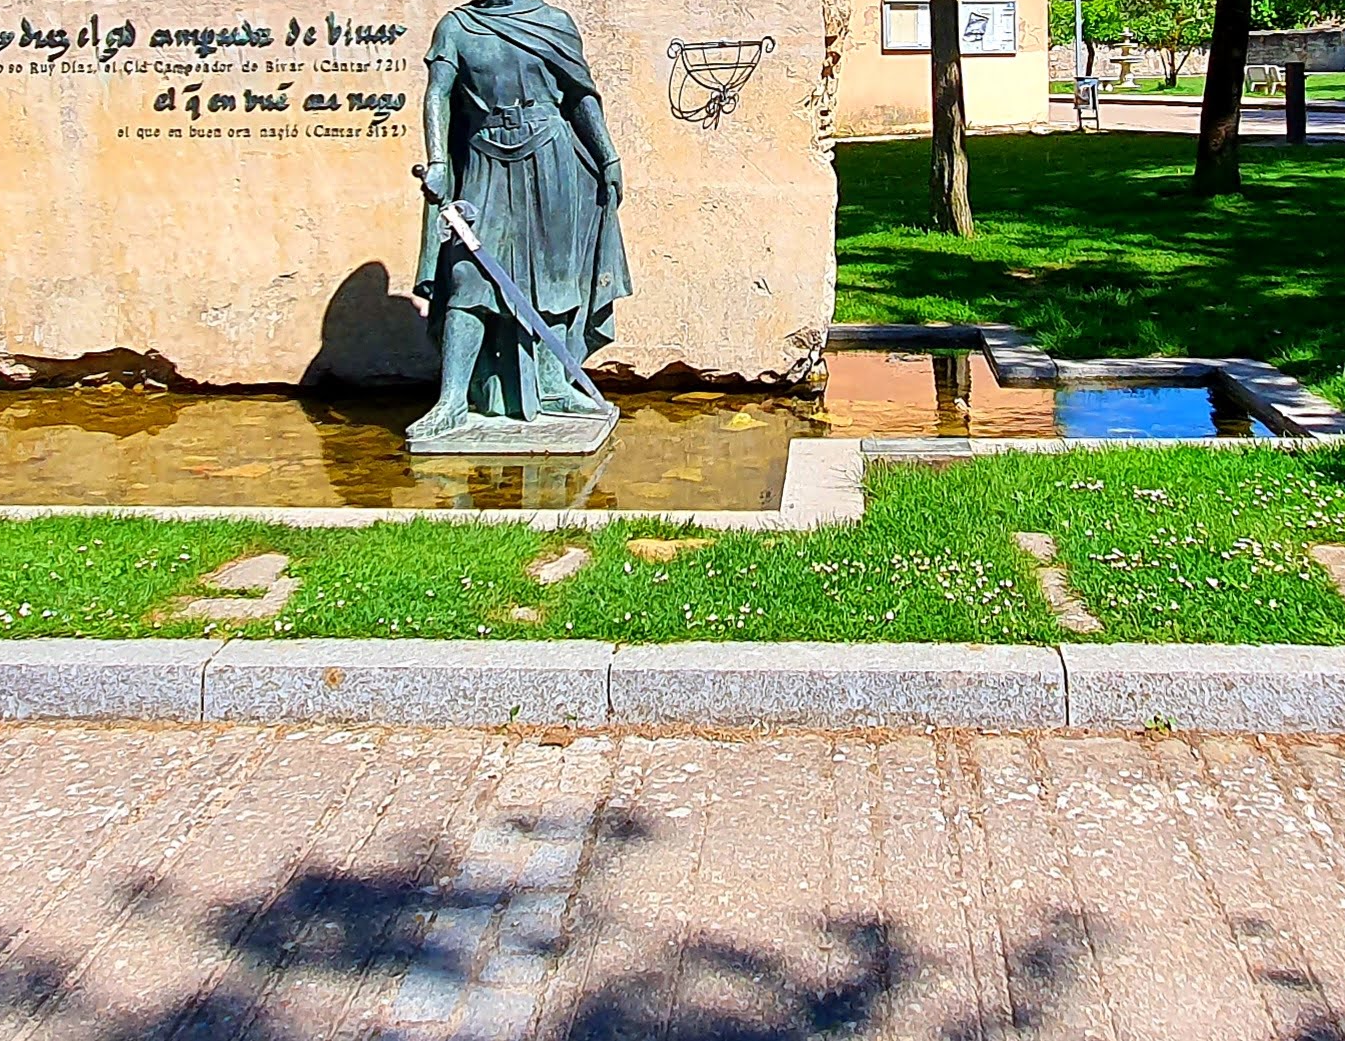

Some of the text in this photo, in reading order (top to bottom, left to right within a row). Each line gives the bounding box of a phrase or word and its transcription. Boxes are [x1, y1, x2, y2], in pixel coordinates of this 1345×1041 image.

[8, 63, 23, 74] so
[30, 61, 56, 77] Ruy
[104, 61, 117, 73] el
[153, 60, 233, 76] Campeador
[241, 61, 258, 73] de
[265, 59, 305, 73] Bivar
[313, 59, 371, 73] (Cantar
[375, 58, 407, 72] 721)
[117, 126, 130, 138] el
[136, 127, 160, 140] que
[168, 128, 183, 138] en
[189, 125, 222, 138] buen
[227, 128, 251, 138] ora
[306, 124, 362, 138] (Cantar
